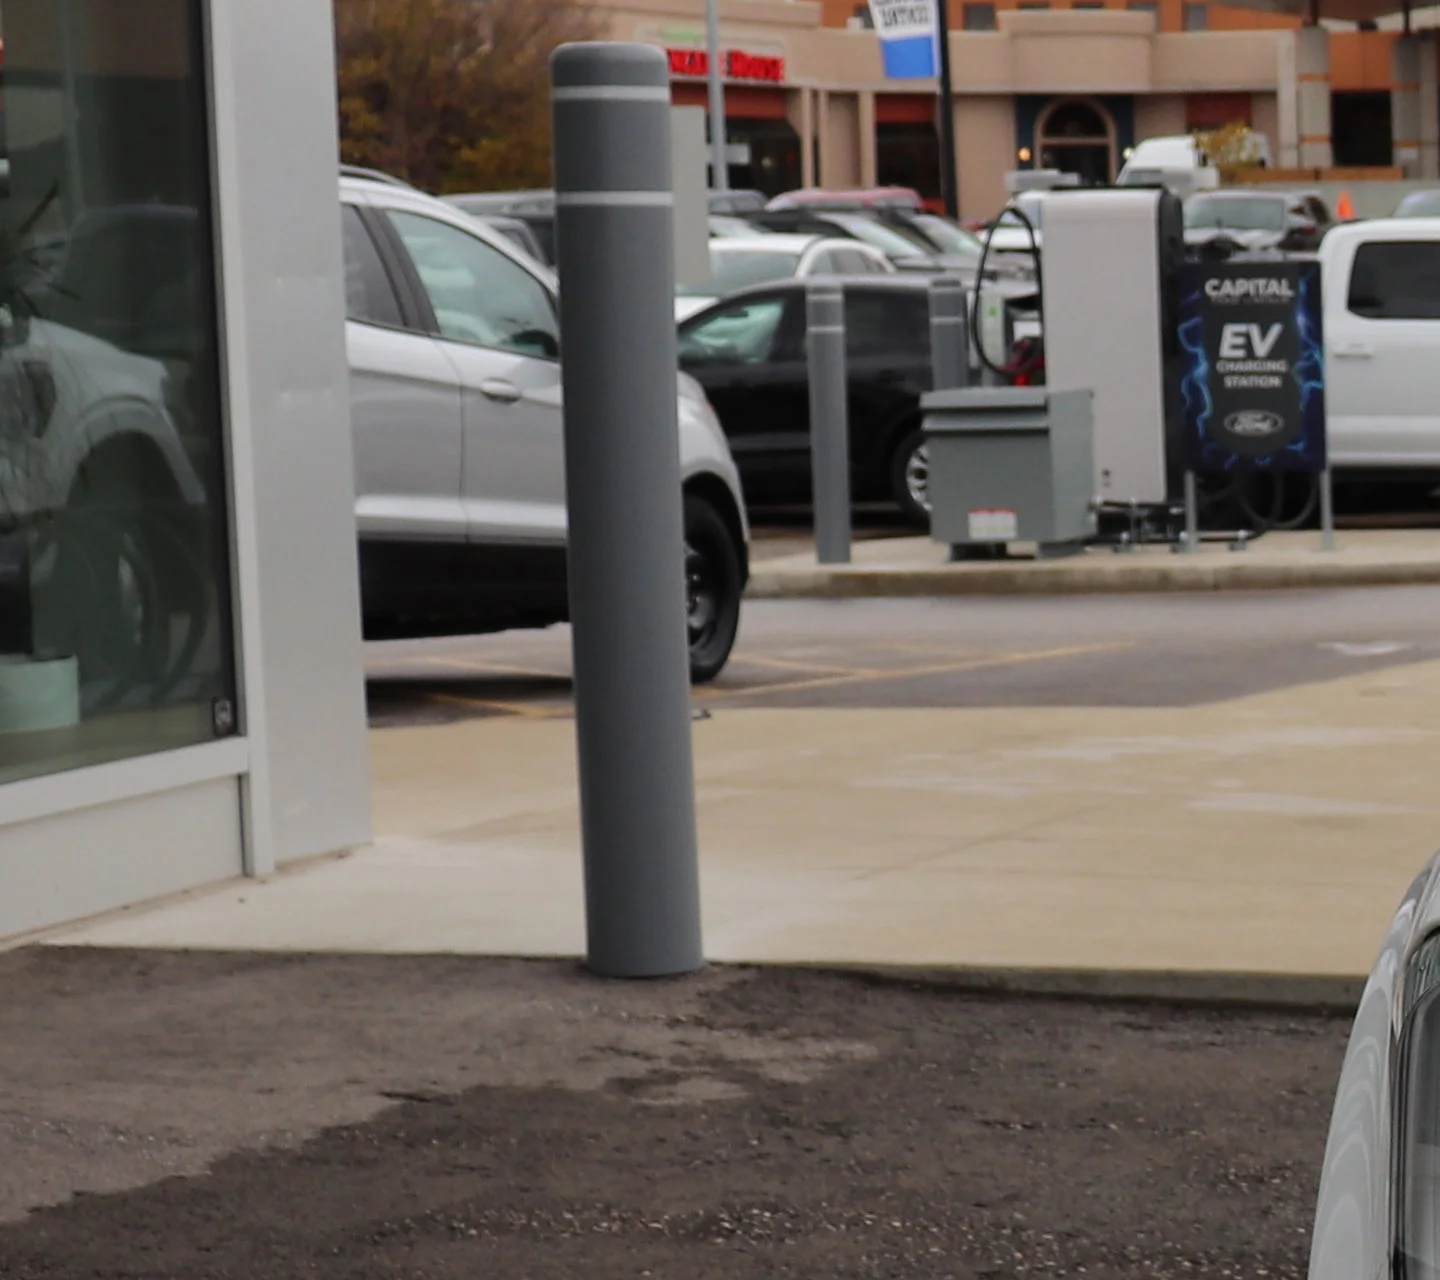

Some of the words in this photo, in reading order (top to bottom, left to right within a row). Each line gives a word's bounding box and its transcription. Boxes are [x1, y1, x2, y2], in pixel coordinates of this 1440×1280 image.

[1204, 278, 1295, 297] CAPITAL
[1218, 322, 1284, 359] EV
[1216, 359, 1287, 373] CHARGING
[1224, 375, 1283, 389] STATION
